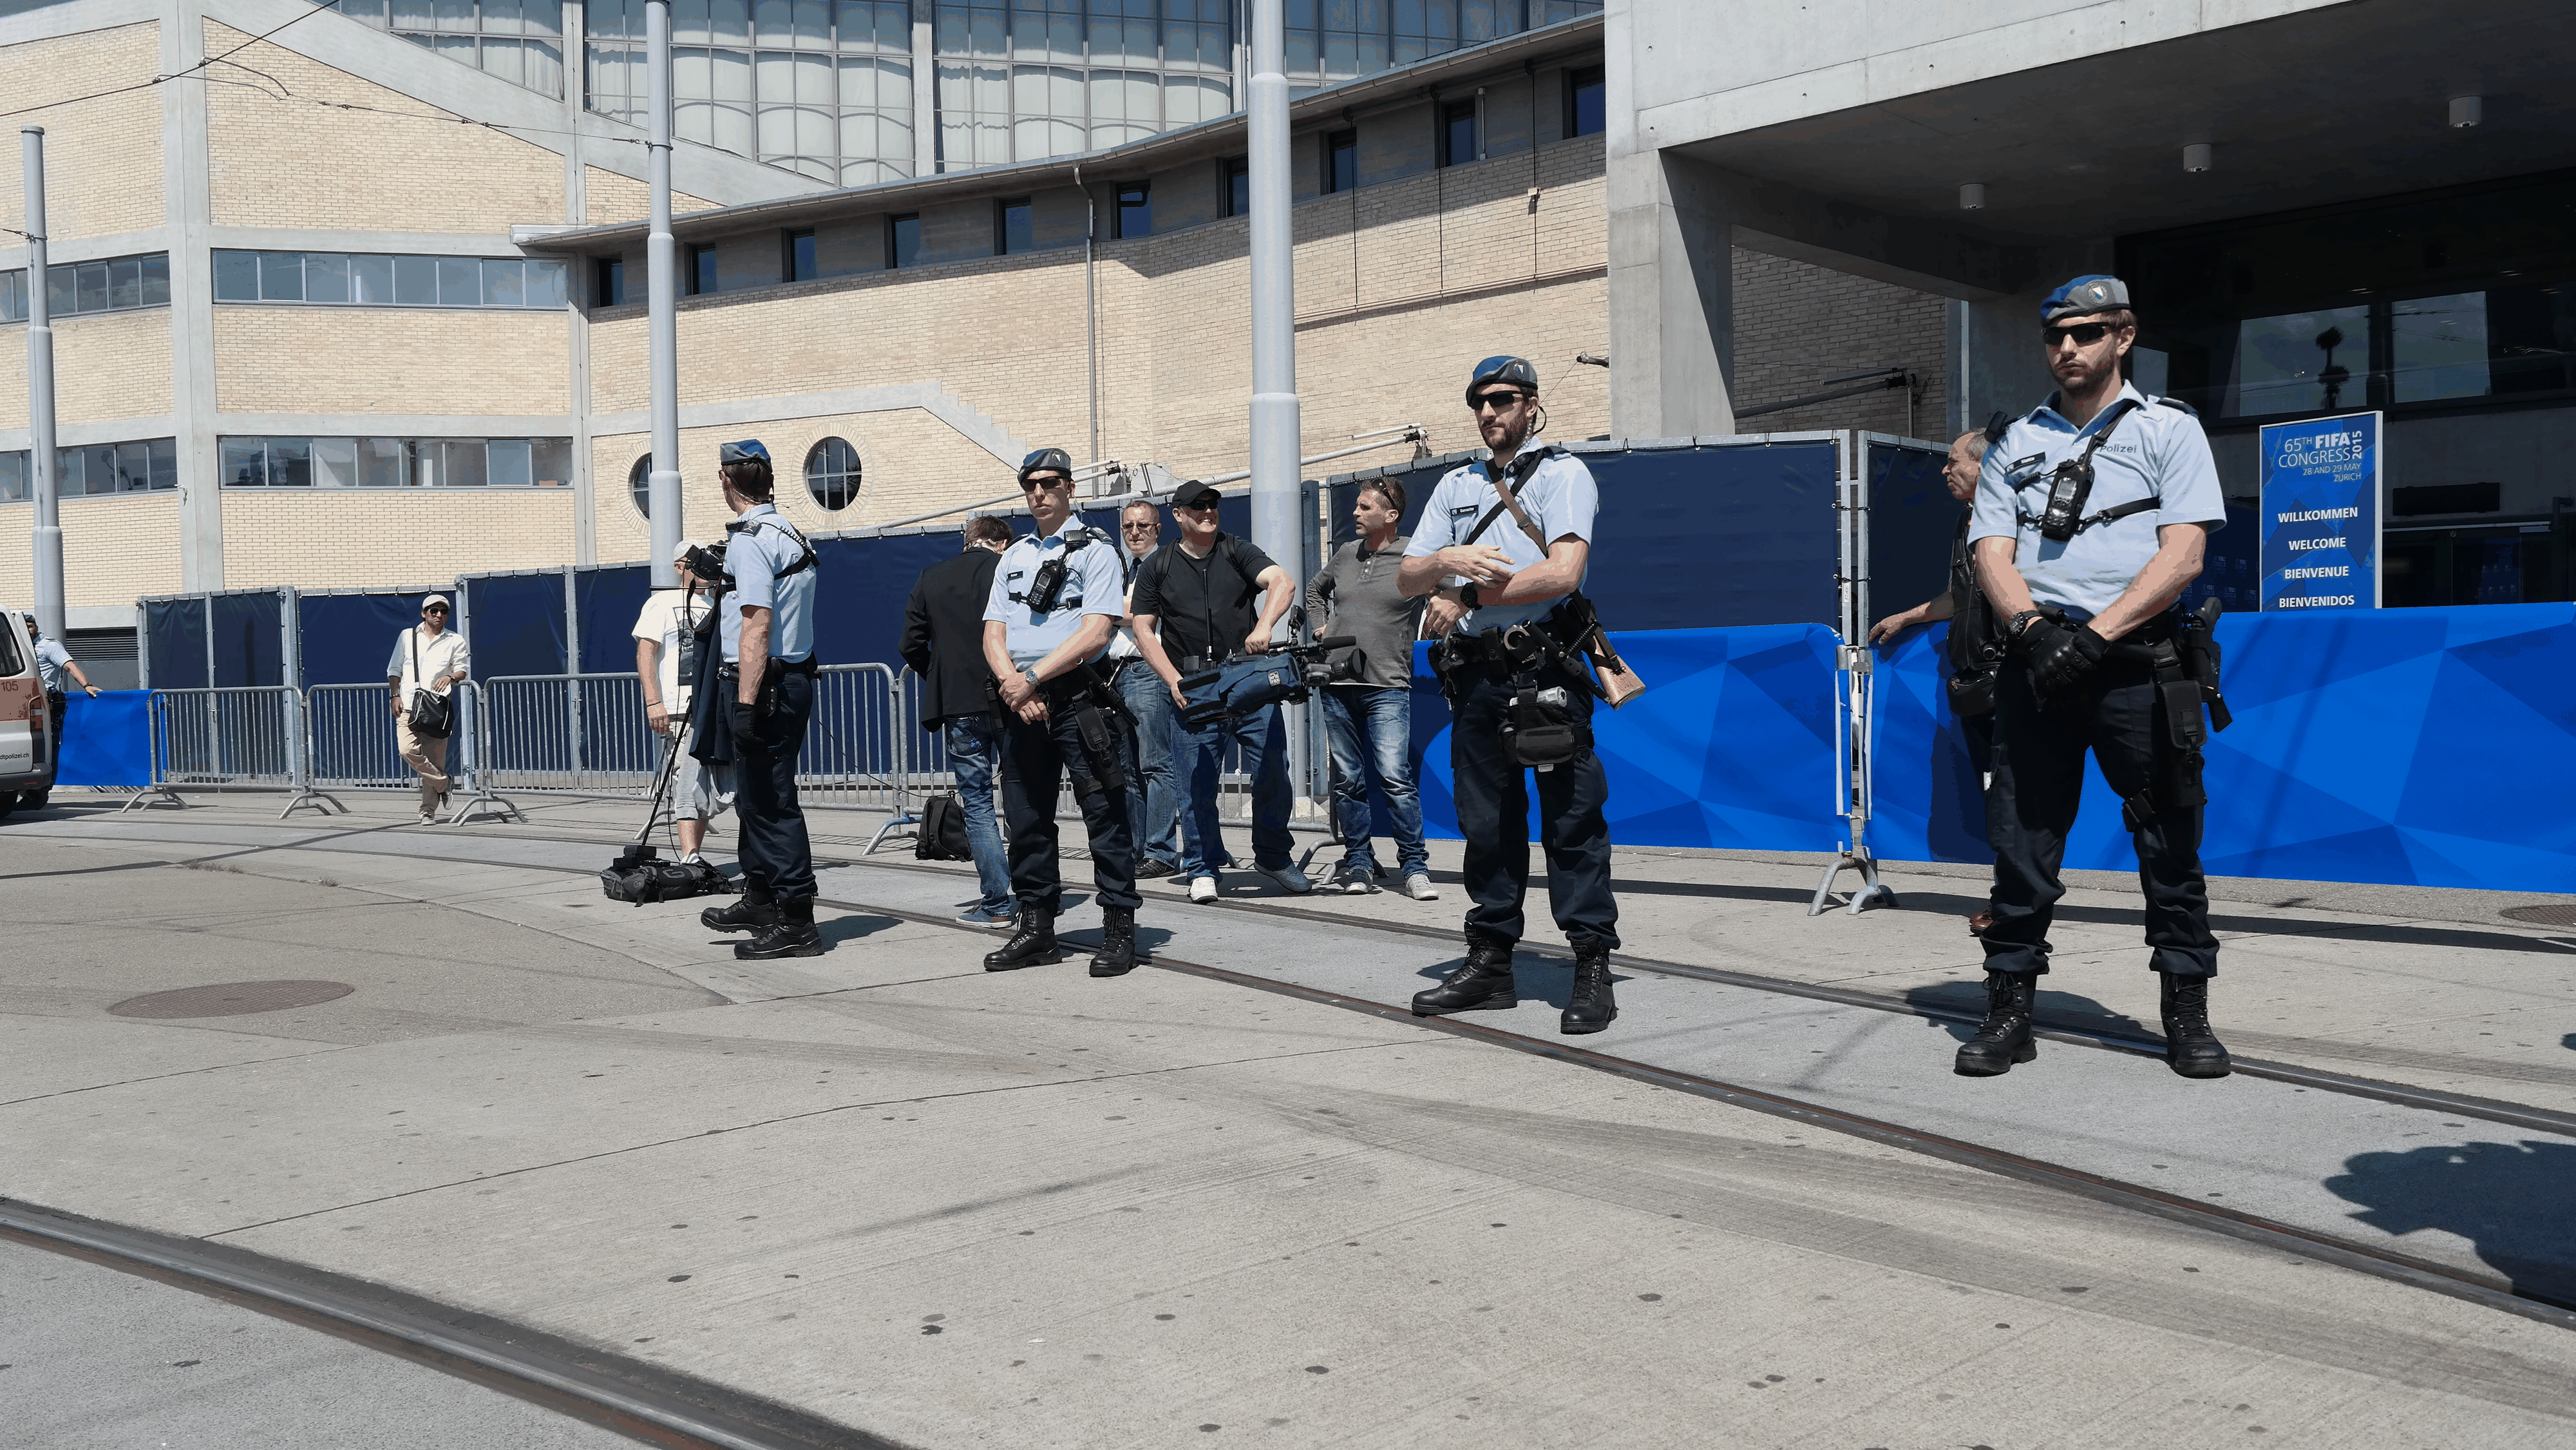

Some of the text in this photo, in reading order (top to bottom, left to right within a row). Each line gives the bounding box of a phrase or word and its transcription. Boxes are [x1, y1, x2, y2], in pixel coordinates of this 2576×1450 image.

[2315, 432, 2351, 449] FIFA
[2352, 430, 2362, 459] 2015
[2101, 444, 2137, 453] Polizei
[2278, 447, 2351, 468] CONGRESS
[2315, 466, 2331, 474] AND
[2333, 464, 2342, 473] 29
[2344, 463, 2362, 471] MAY
[2334, 472, 2362, 482] ZURICH
[2278, 507, 2358, 523] WILLKOMMEN
[2289, 537, 2346, 551] WELCOME
[2285, 566, 2349, 579] BIENVENUE
[2279, 595, 2355, 608] BIENVENIDOS
[1, 680, 19, 692] 105
